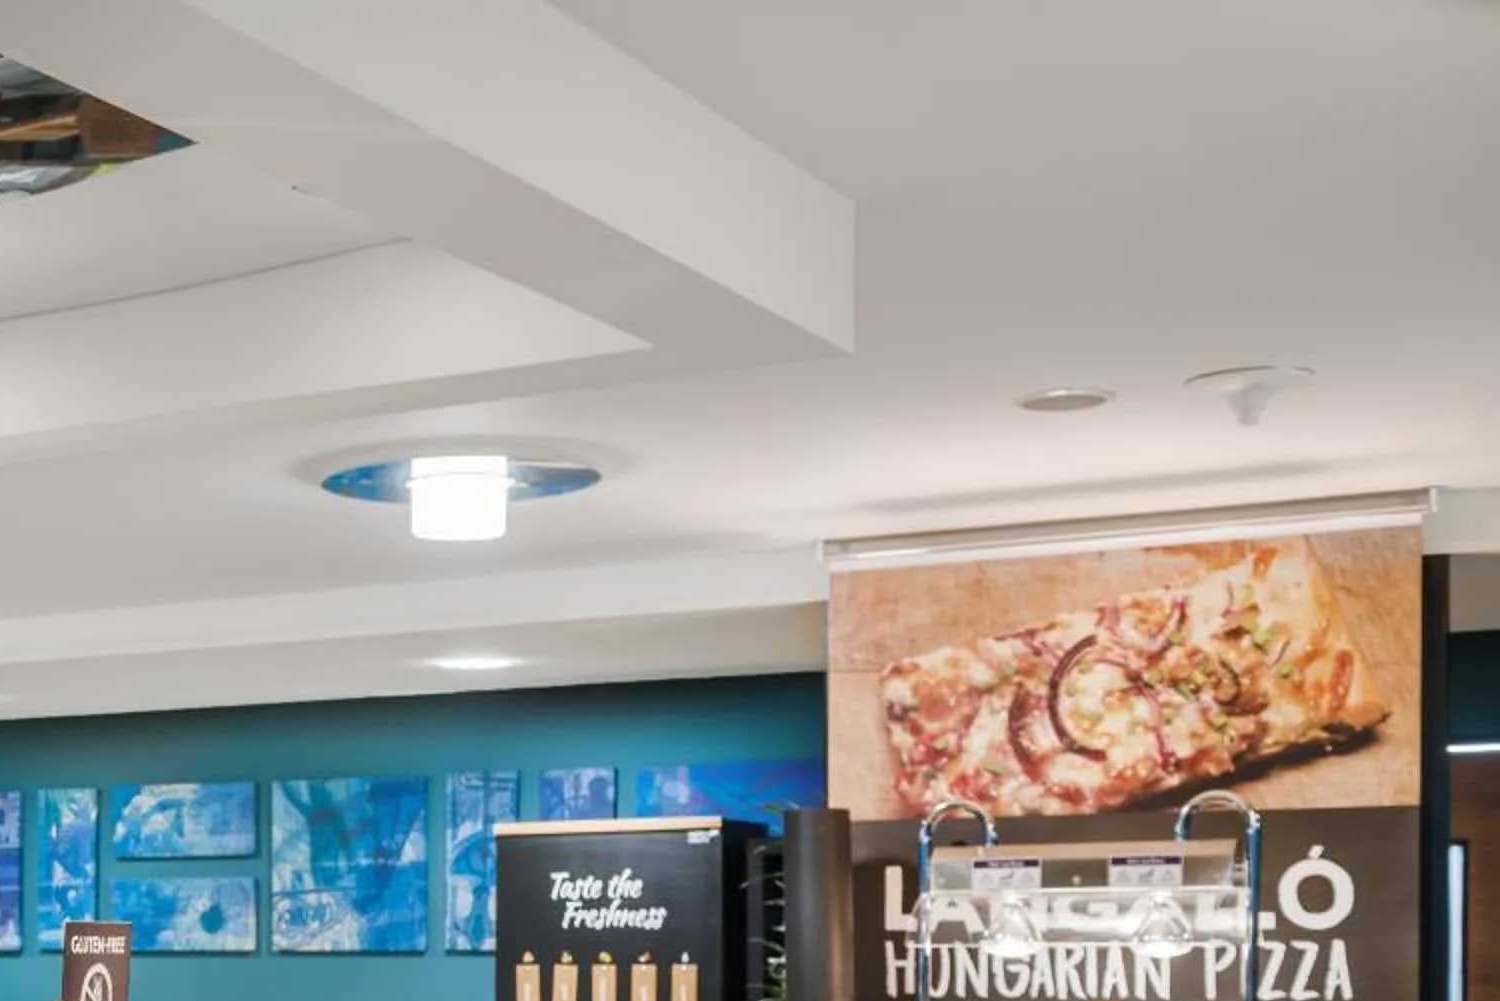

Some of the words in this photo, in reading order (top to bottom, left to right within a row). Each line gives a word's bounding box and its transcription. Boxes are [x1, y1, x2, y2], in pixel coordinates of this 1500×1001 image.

[550, 871, 603, 901] Taste
[607, 867, 643, 899] the
[561, 900, 667, 930] Freshness
[71, 935, 126, 954] GLUTEN-FREE
[884, 939, 1171, 1001] HUNGARIAN
